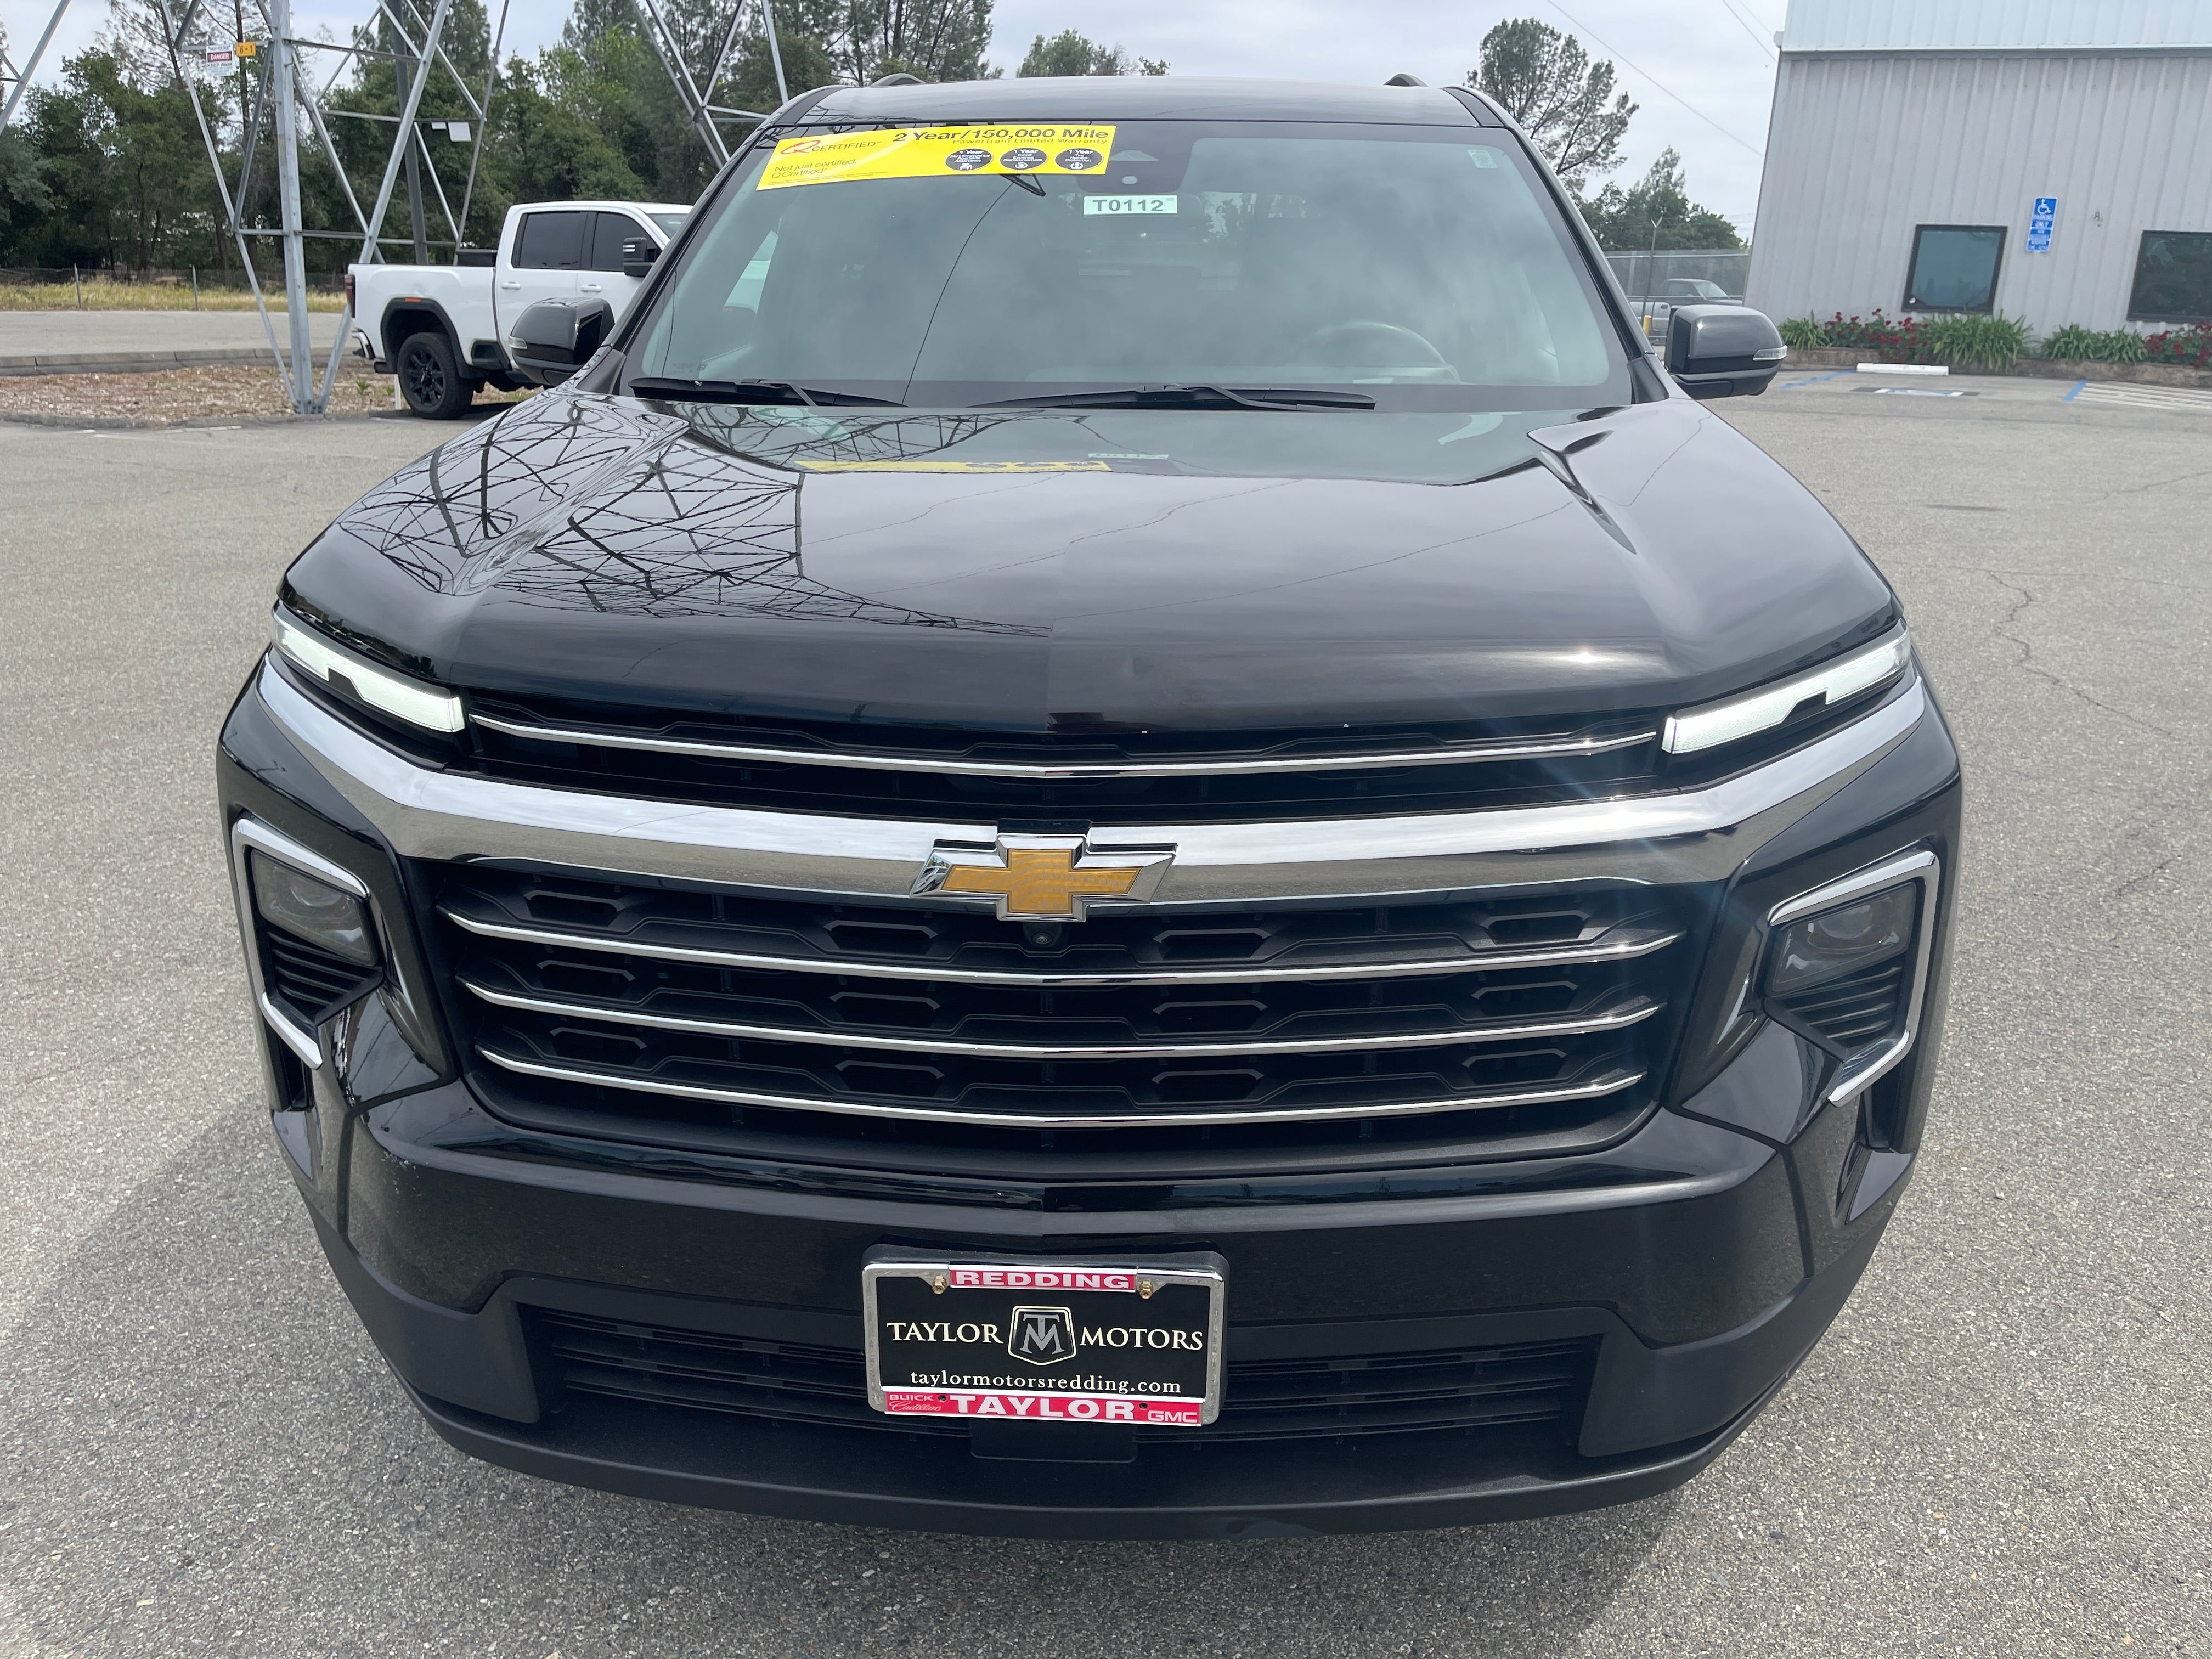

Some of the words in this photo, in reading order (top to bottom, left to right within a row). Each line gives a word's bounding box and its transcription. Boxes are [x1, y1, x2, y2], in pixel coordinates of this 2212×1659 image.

[893, 133, 907, 142] 2
[913, 129, 1056, 140] Year/150,000
[1062, 129, 1108, 138] Mile
[1092, 199, 1164, 211] T0112
[955, 1271, 1130, 1289] REDDING
[887, 1322, 1004, 1344] TAYLOR
[1080, 1326, 1203, 1351] MOTORS
[911, 1370, 1181, 1393] taylormotorsredding.com
[889, 1401, 942, 1412] Cadillac
[950, 1394, 1136, 1421] TAYLOR
[1147, 1410, 1198, 1424] GMC
